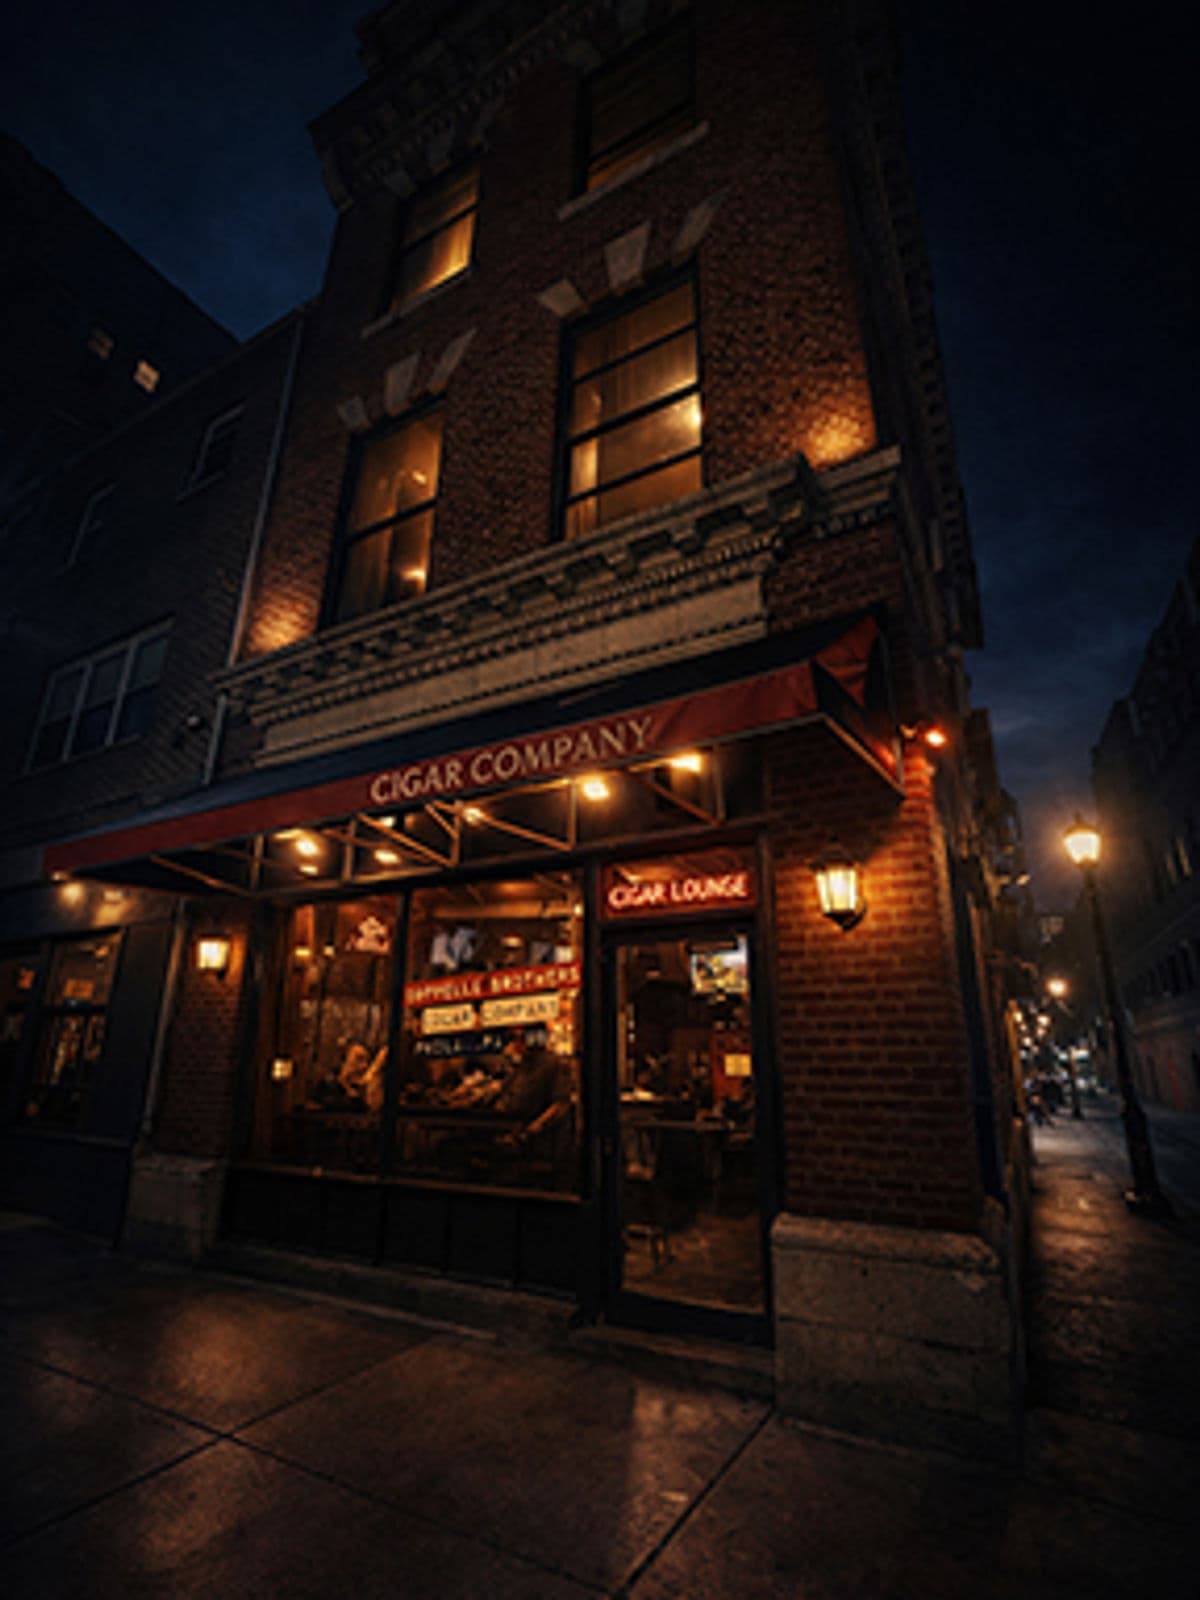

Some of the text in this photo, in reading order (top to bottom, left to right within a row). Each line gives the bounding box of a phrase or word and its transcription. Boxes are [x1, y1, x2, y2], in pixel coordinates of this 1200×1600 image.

[370, 716, 652, 803] CIGAR COMPANY
[608, 872, 748, 909] CIGAR LOUNGE
